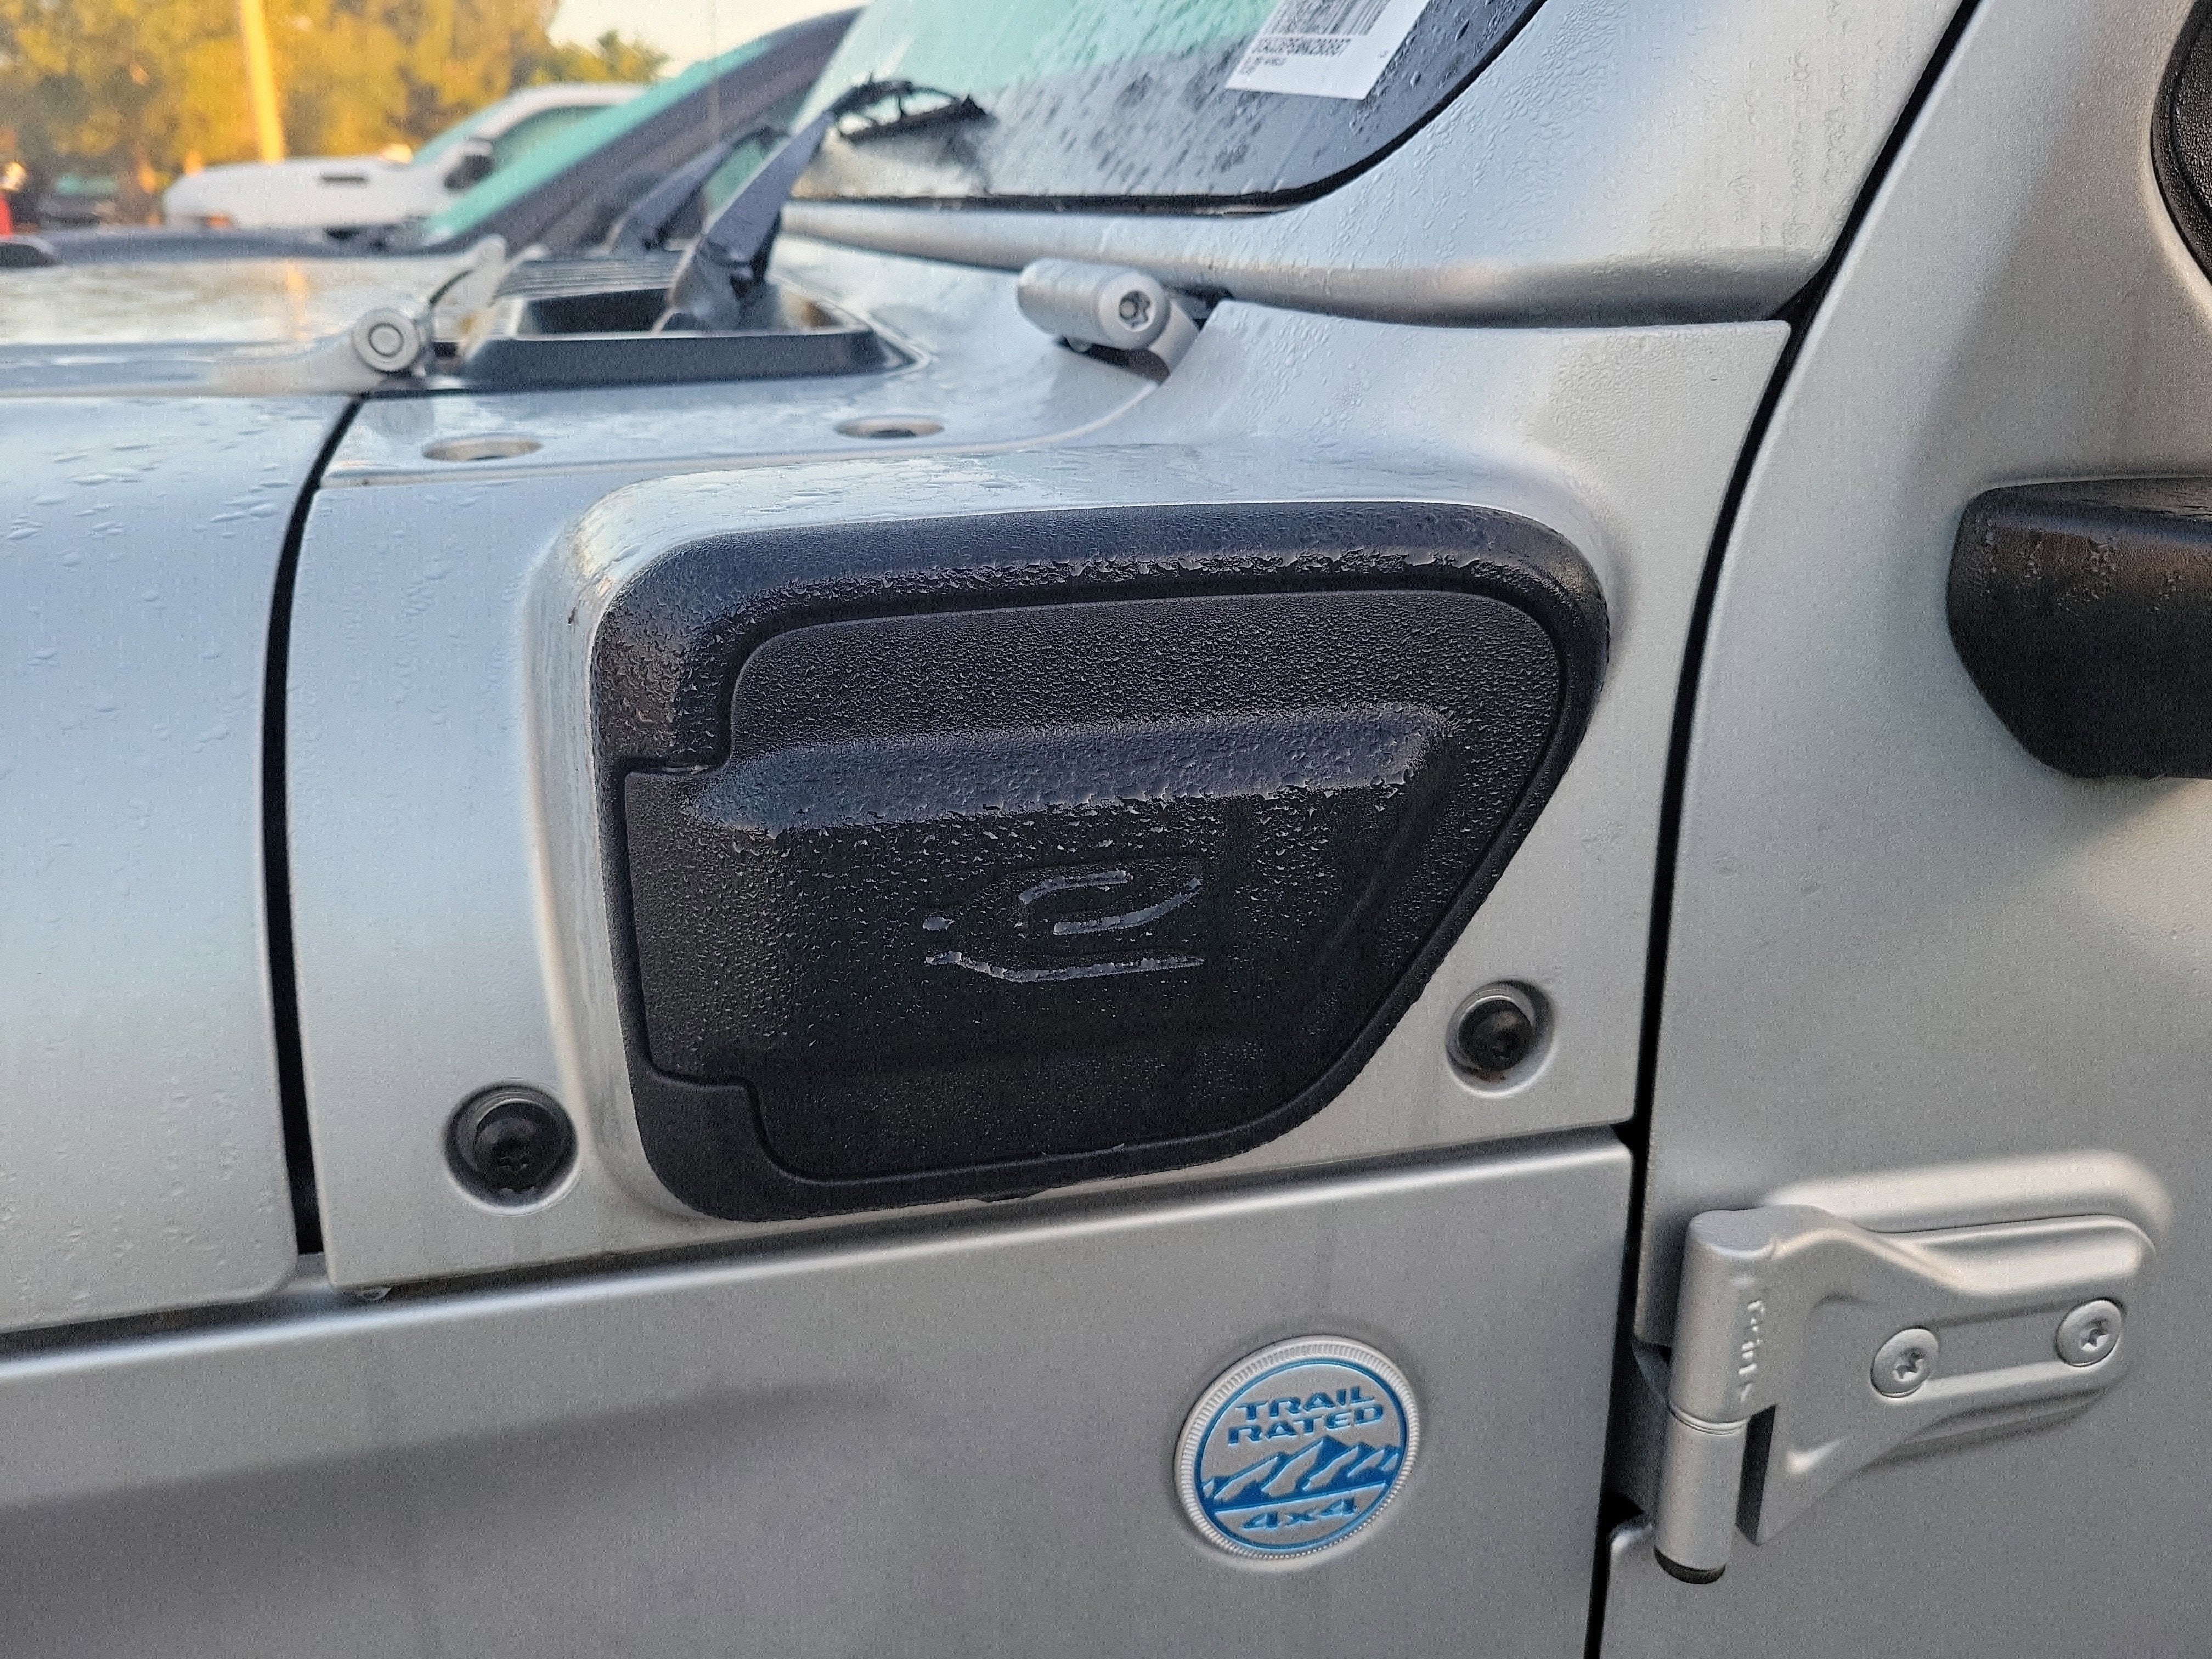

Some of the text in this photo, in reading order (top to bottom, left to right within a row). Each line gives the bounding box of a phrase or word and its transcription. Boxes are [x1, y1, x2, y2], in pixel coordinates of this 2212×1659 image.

[1234, 1385, 1377, 1421] TRAIL
[1227, 1403, 1384, 1446] RATED
[1239, 1497, 1358, 1530] 4x4
